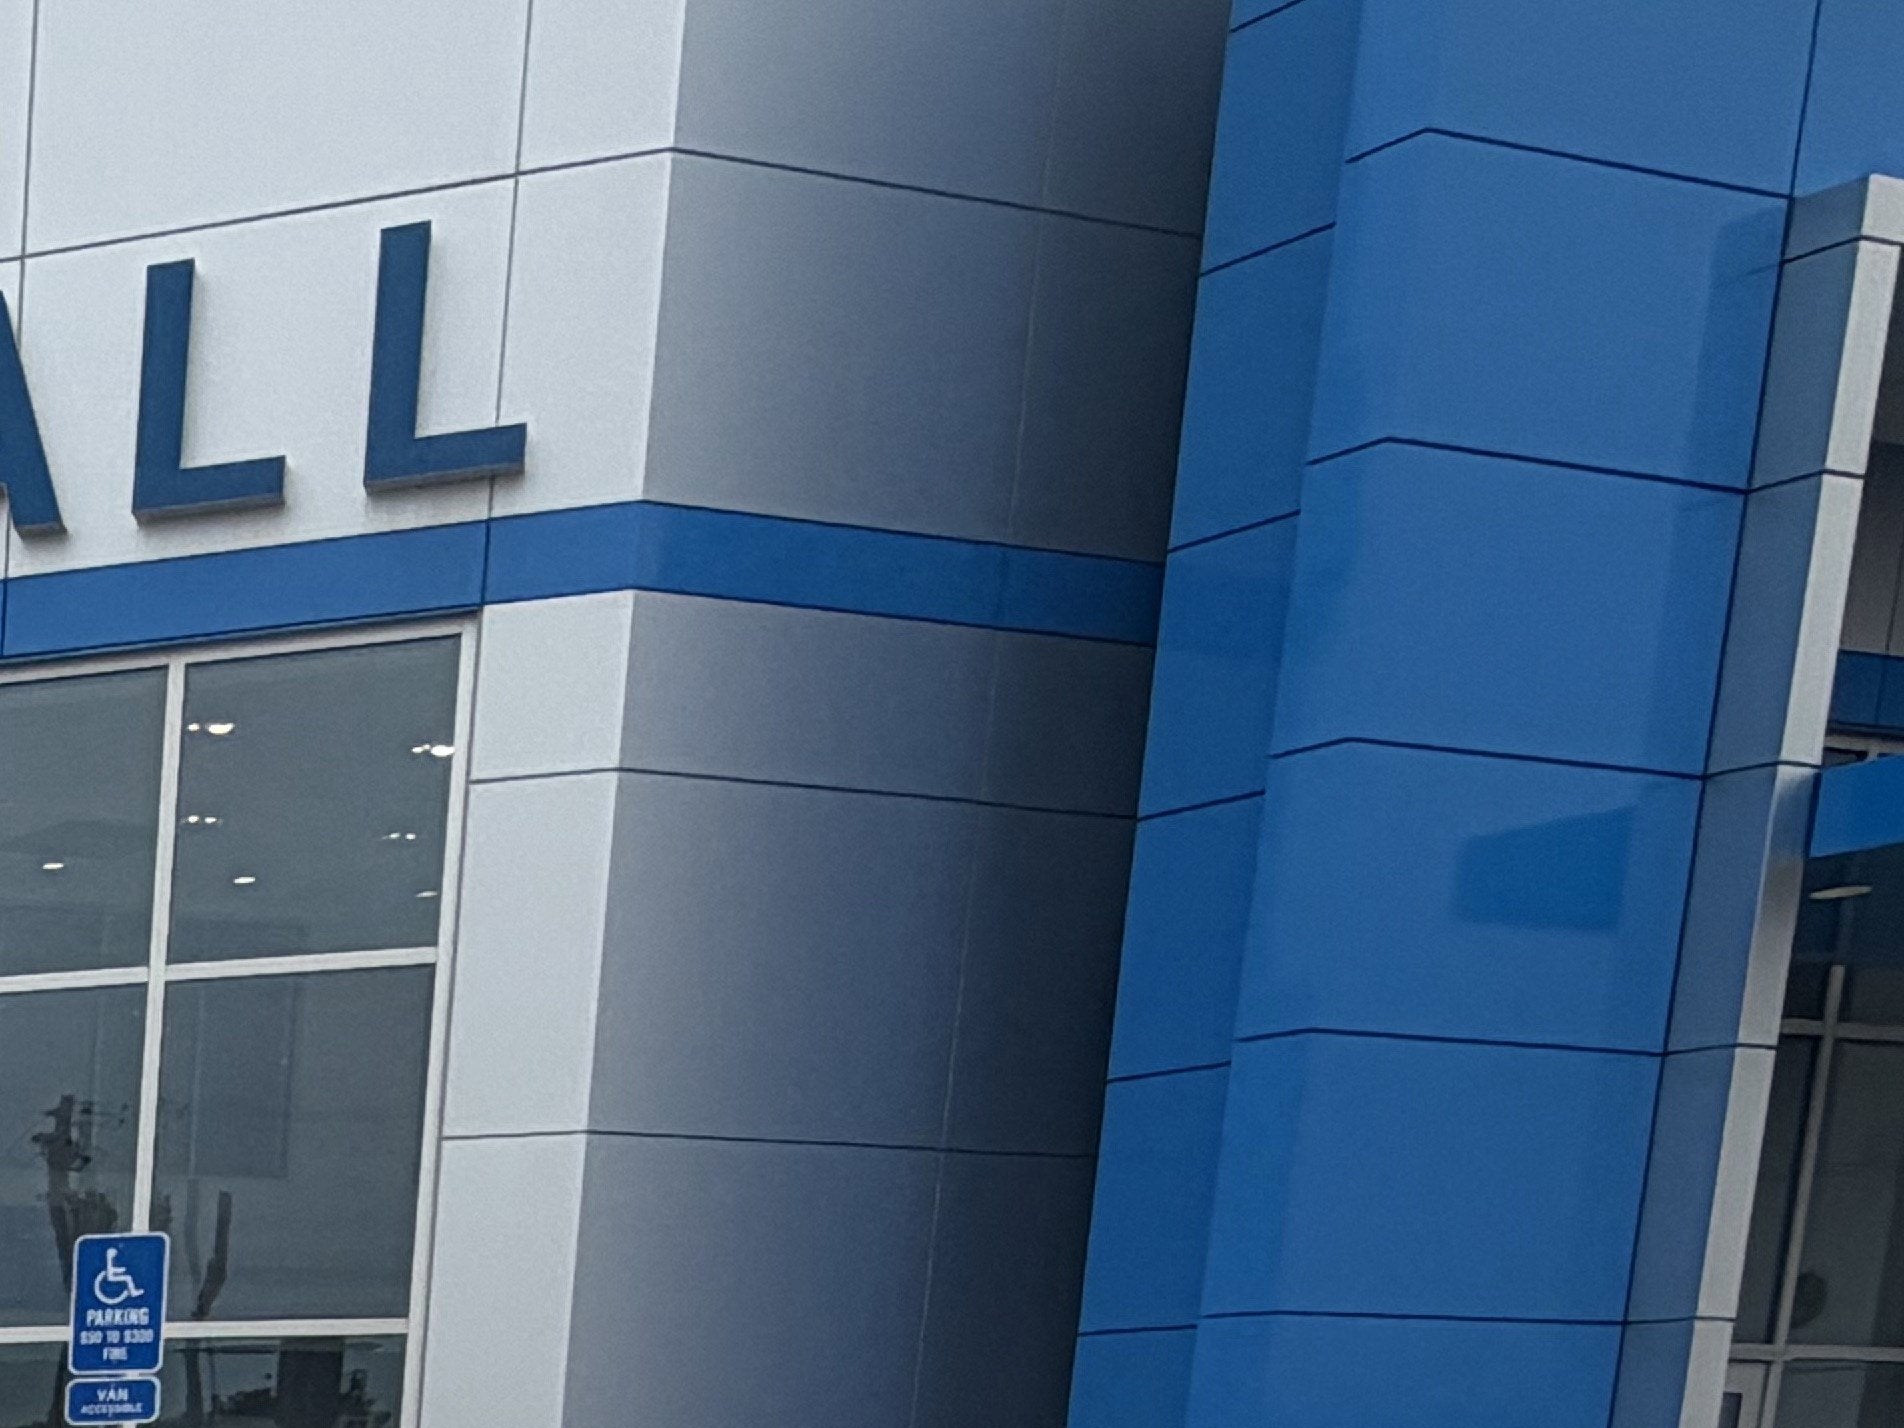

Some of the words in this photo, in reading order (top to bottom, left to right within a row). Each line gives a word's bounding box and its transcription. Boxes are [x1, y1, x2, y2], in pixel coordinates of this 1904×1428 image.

[86, 1307, 150, 1327] PARKING
[106, 1330, 120, 1343] TO
[96, 1388, 129, 1402] VAN
